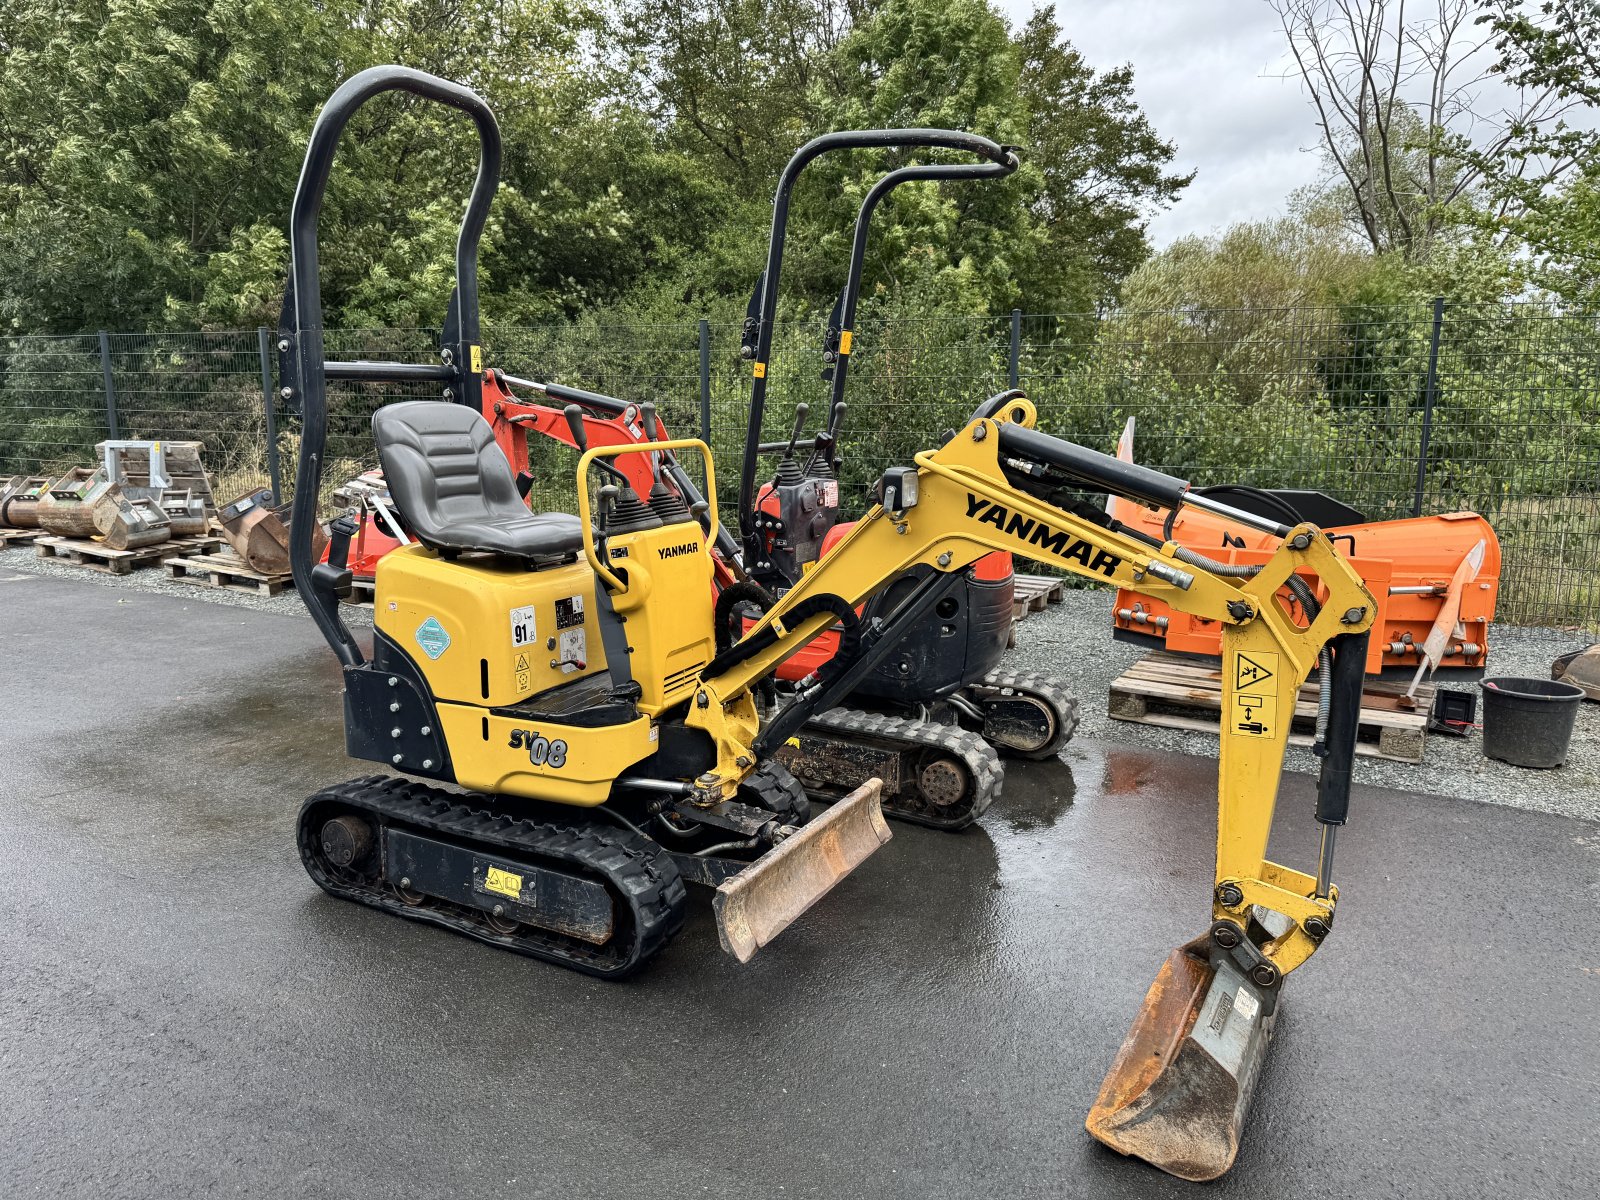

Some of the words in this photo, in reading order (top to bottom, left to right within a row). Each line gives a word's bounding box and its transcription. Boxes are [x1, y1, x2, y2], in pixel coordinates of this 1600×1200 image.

[965, 493, 1122, 577] YANMAR
[657, 542, 698, 560] YANMAR
[515, 623, 527, 643] 91
[508, 729, 568, 769] SV08
